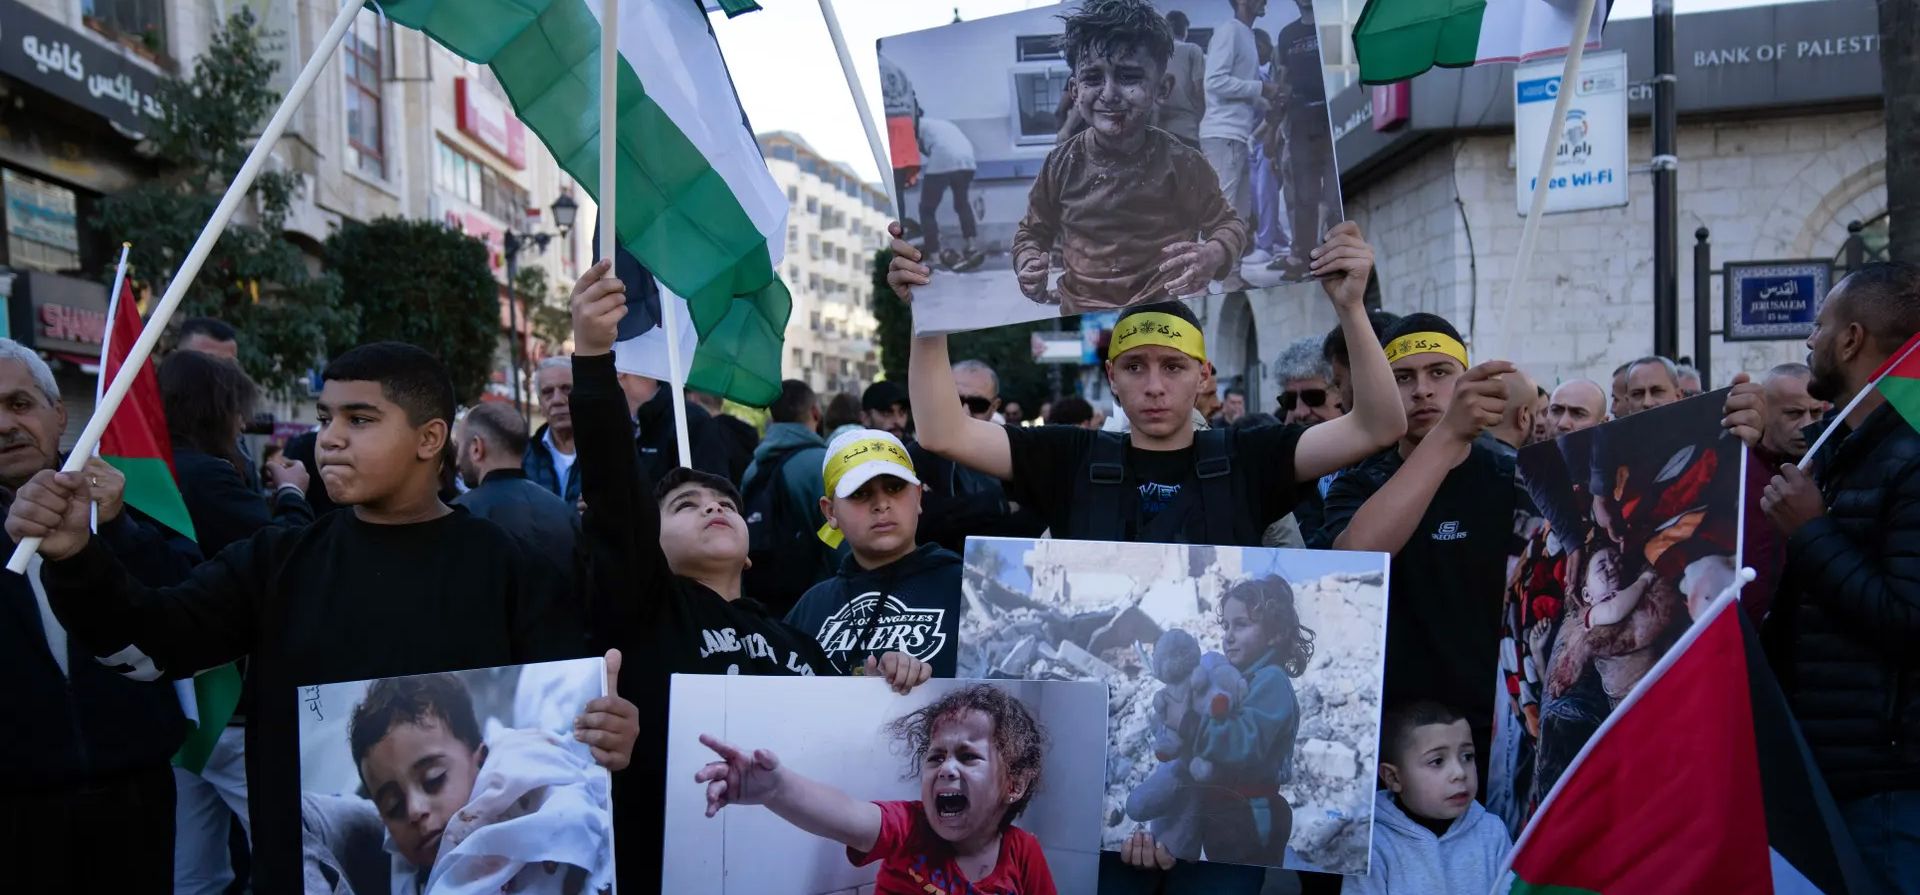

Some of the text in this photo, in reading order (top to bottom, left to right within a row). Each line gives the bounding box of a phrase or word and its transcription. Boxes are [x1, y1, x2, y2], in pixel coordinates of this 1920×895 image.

[22, 35, 84, 81] كافيه
[1694, 34, 1880, 67] BANK OF PALESTI
[88, 73, 140, 116] باكس
[1530, 168, 1613, 192] Fee Wi-Fi
[1760, 280, 1798, 299] القدس
[1750, 300, 1806, 313] JERUSALEM
[40, 302, 104, 344] SHAW
[1118, 324, 1182, 345] حركة فتح
[1415, 339, 1442, 351] حركة
[843, 445, 868, 463] فتح
[878, 614, 933, 624] ANGELES
